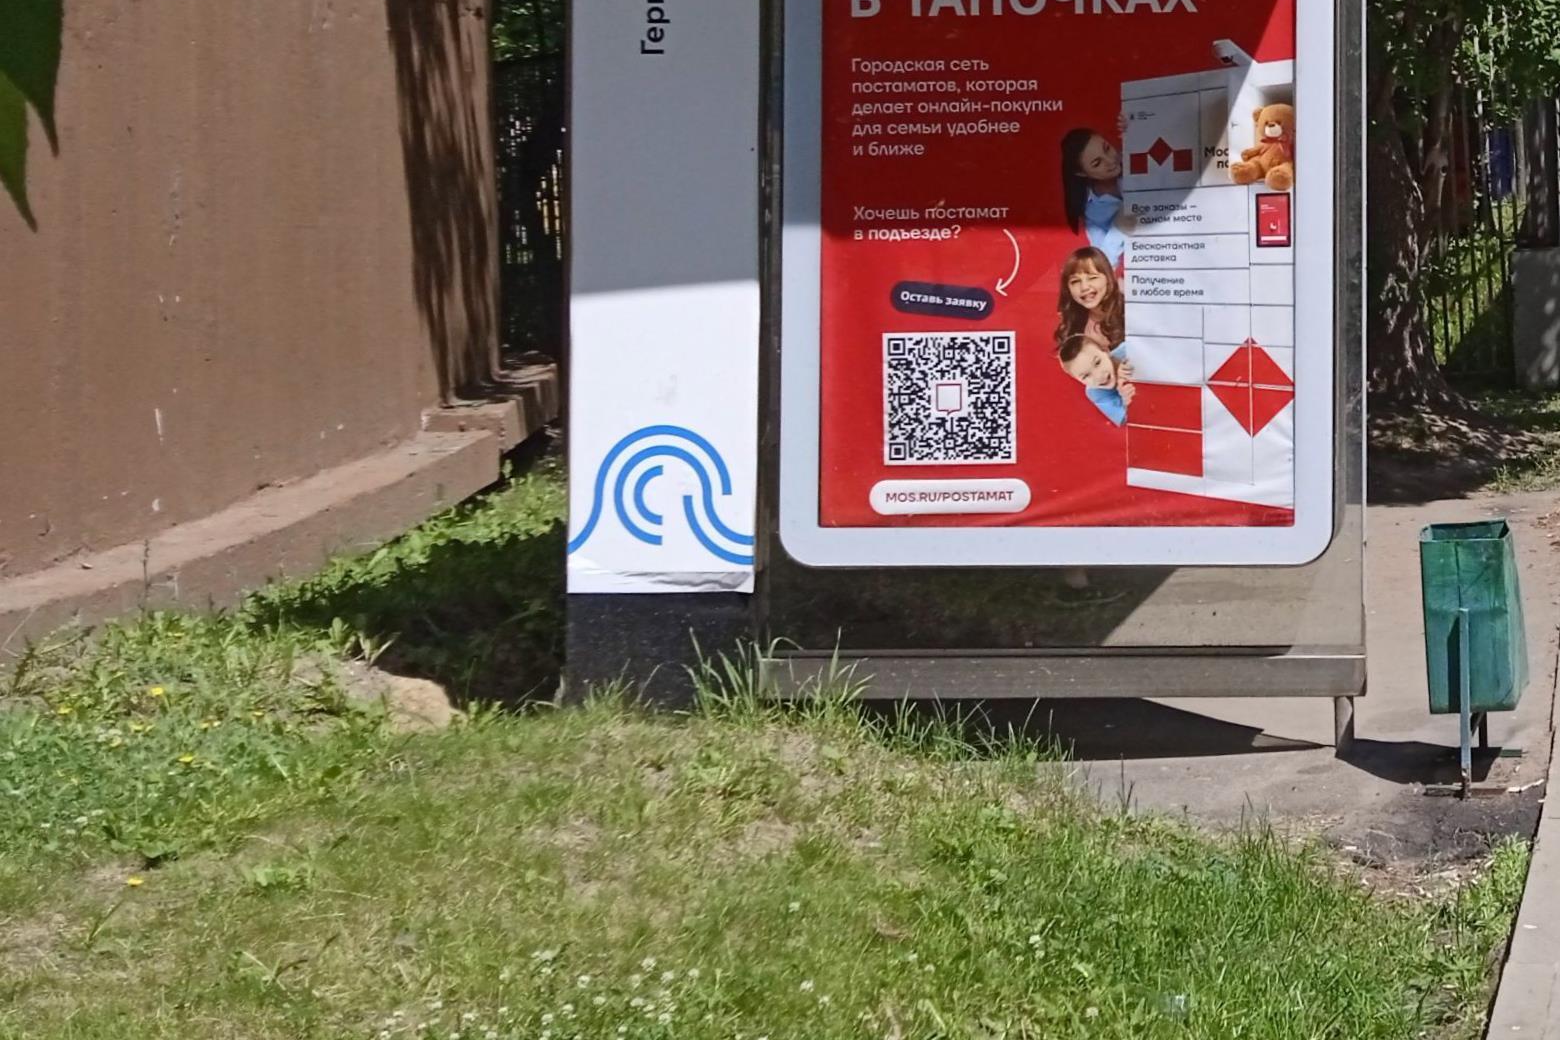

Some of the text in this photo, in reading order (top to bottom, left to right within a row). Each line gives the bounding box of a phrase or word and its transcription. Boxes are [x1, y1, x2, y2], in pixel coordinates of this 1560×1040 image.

[851, 58, 990, 75] Городская сеть
[851, 78, 1038, 95] постаматов, которая
[851, 98, 1064, 116] делает онлайн-покупки
[851, 119, 1021, 137] для семьи удобнее
[852, 140, 925, 156] и ближе
[853, 206, 1010, 221] Хочешь постамат
[853, 224, 963, 242] в подъезде?
[1131, 241, 1206, 251] Бесконтактная
[1131, 253, 1177, 263] доставка
[1131, 275, 1185, 286] Получение
[1139, 287, 1171, 297] любое
[1173, 288, 1205, 298] время
[900, 290, 987, 312] Оставь заявку
[885, 490, 1015, 503] MOS.RU/POSTAMAT
